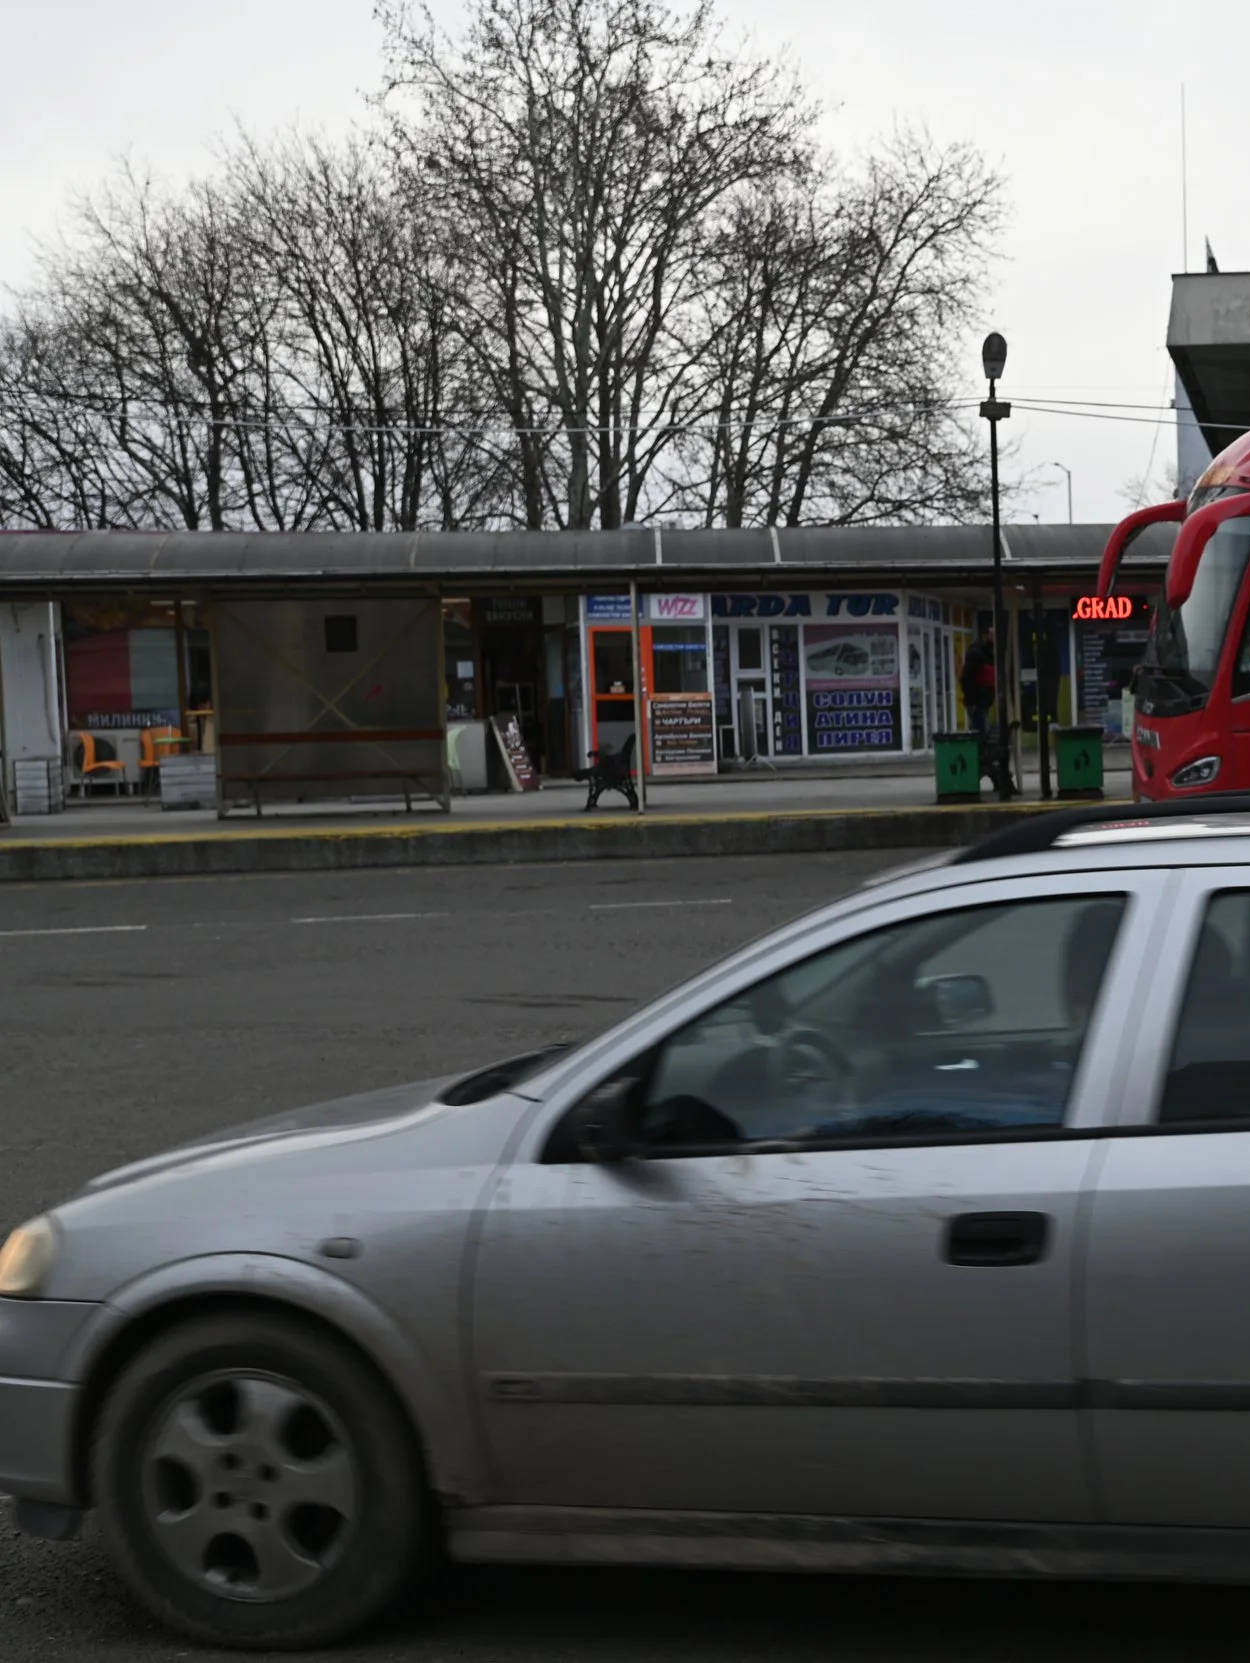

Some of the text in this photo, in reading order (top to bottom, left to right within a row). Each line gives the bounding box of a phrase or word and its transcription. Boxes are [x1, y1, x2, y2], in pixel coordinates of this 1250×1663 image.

[825, 594, 900, 616] TUR
[1072, 596, 1133, 620] GRAD
[813, 690, 893, 708] СОЛУН
[814, 709, 894, 728] АТИНА
[816, 728, 893, 748] ПИРЕЯ
